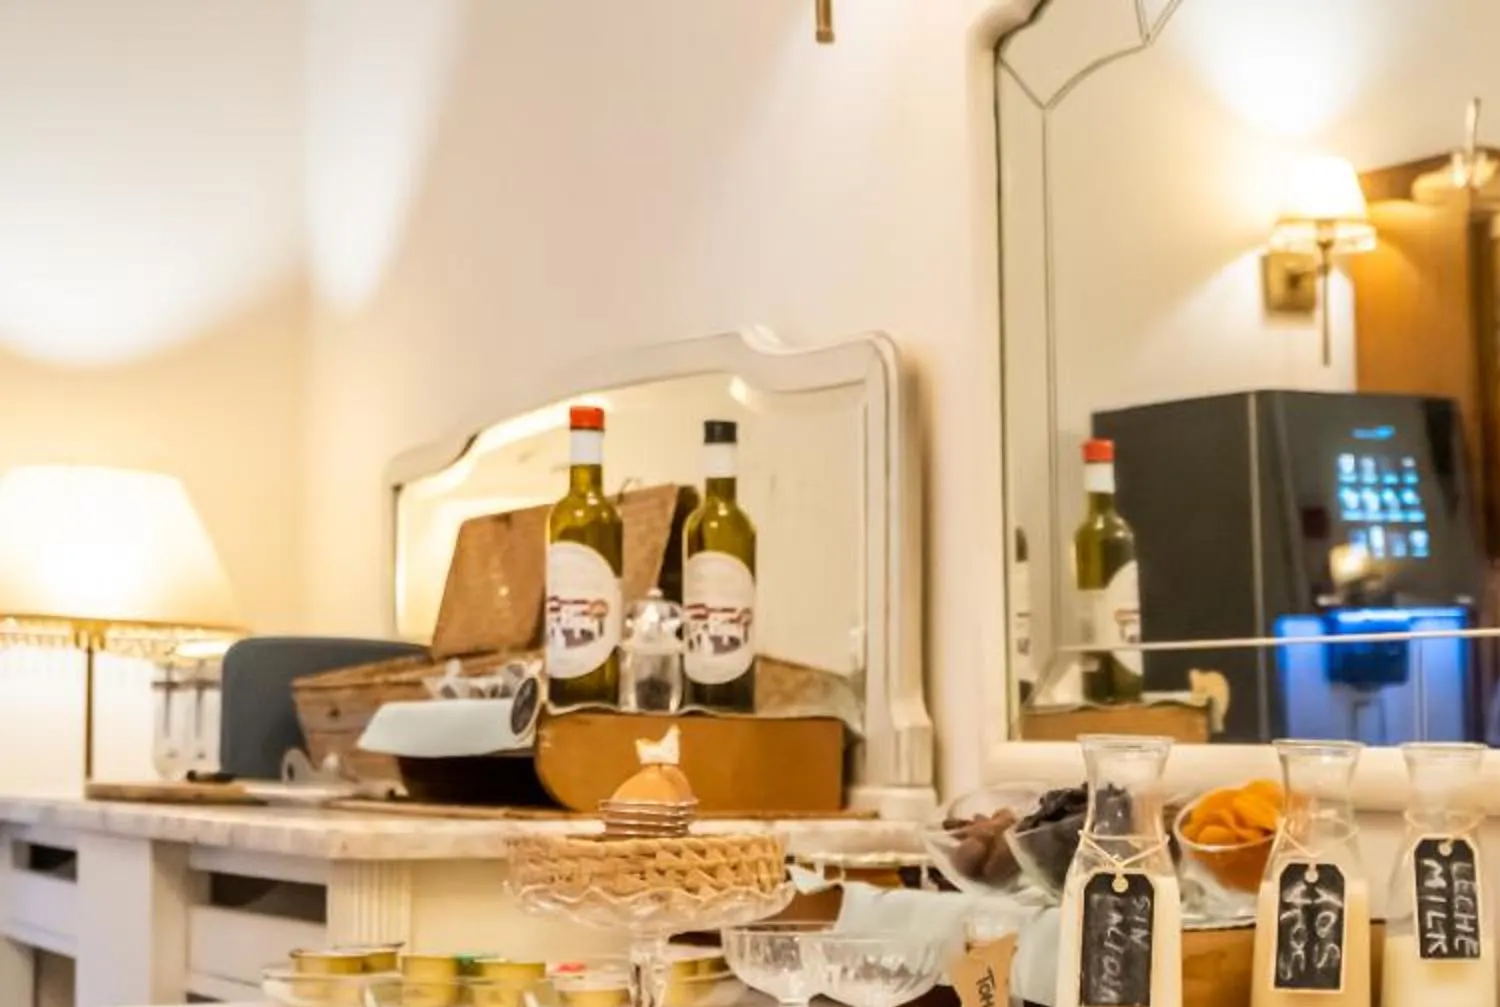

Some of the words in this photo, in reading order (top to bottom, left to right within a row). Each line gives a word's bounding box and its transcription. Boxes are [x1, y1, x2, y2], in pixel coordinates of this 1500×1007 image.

[1130, 895, 1150, 951] SIN
[1313, 886, 1343, 968] SOY
[1421, 858, 1448, 954] MILK
[1451, 861, 1478, 956] LECHE
